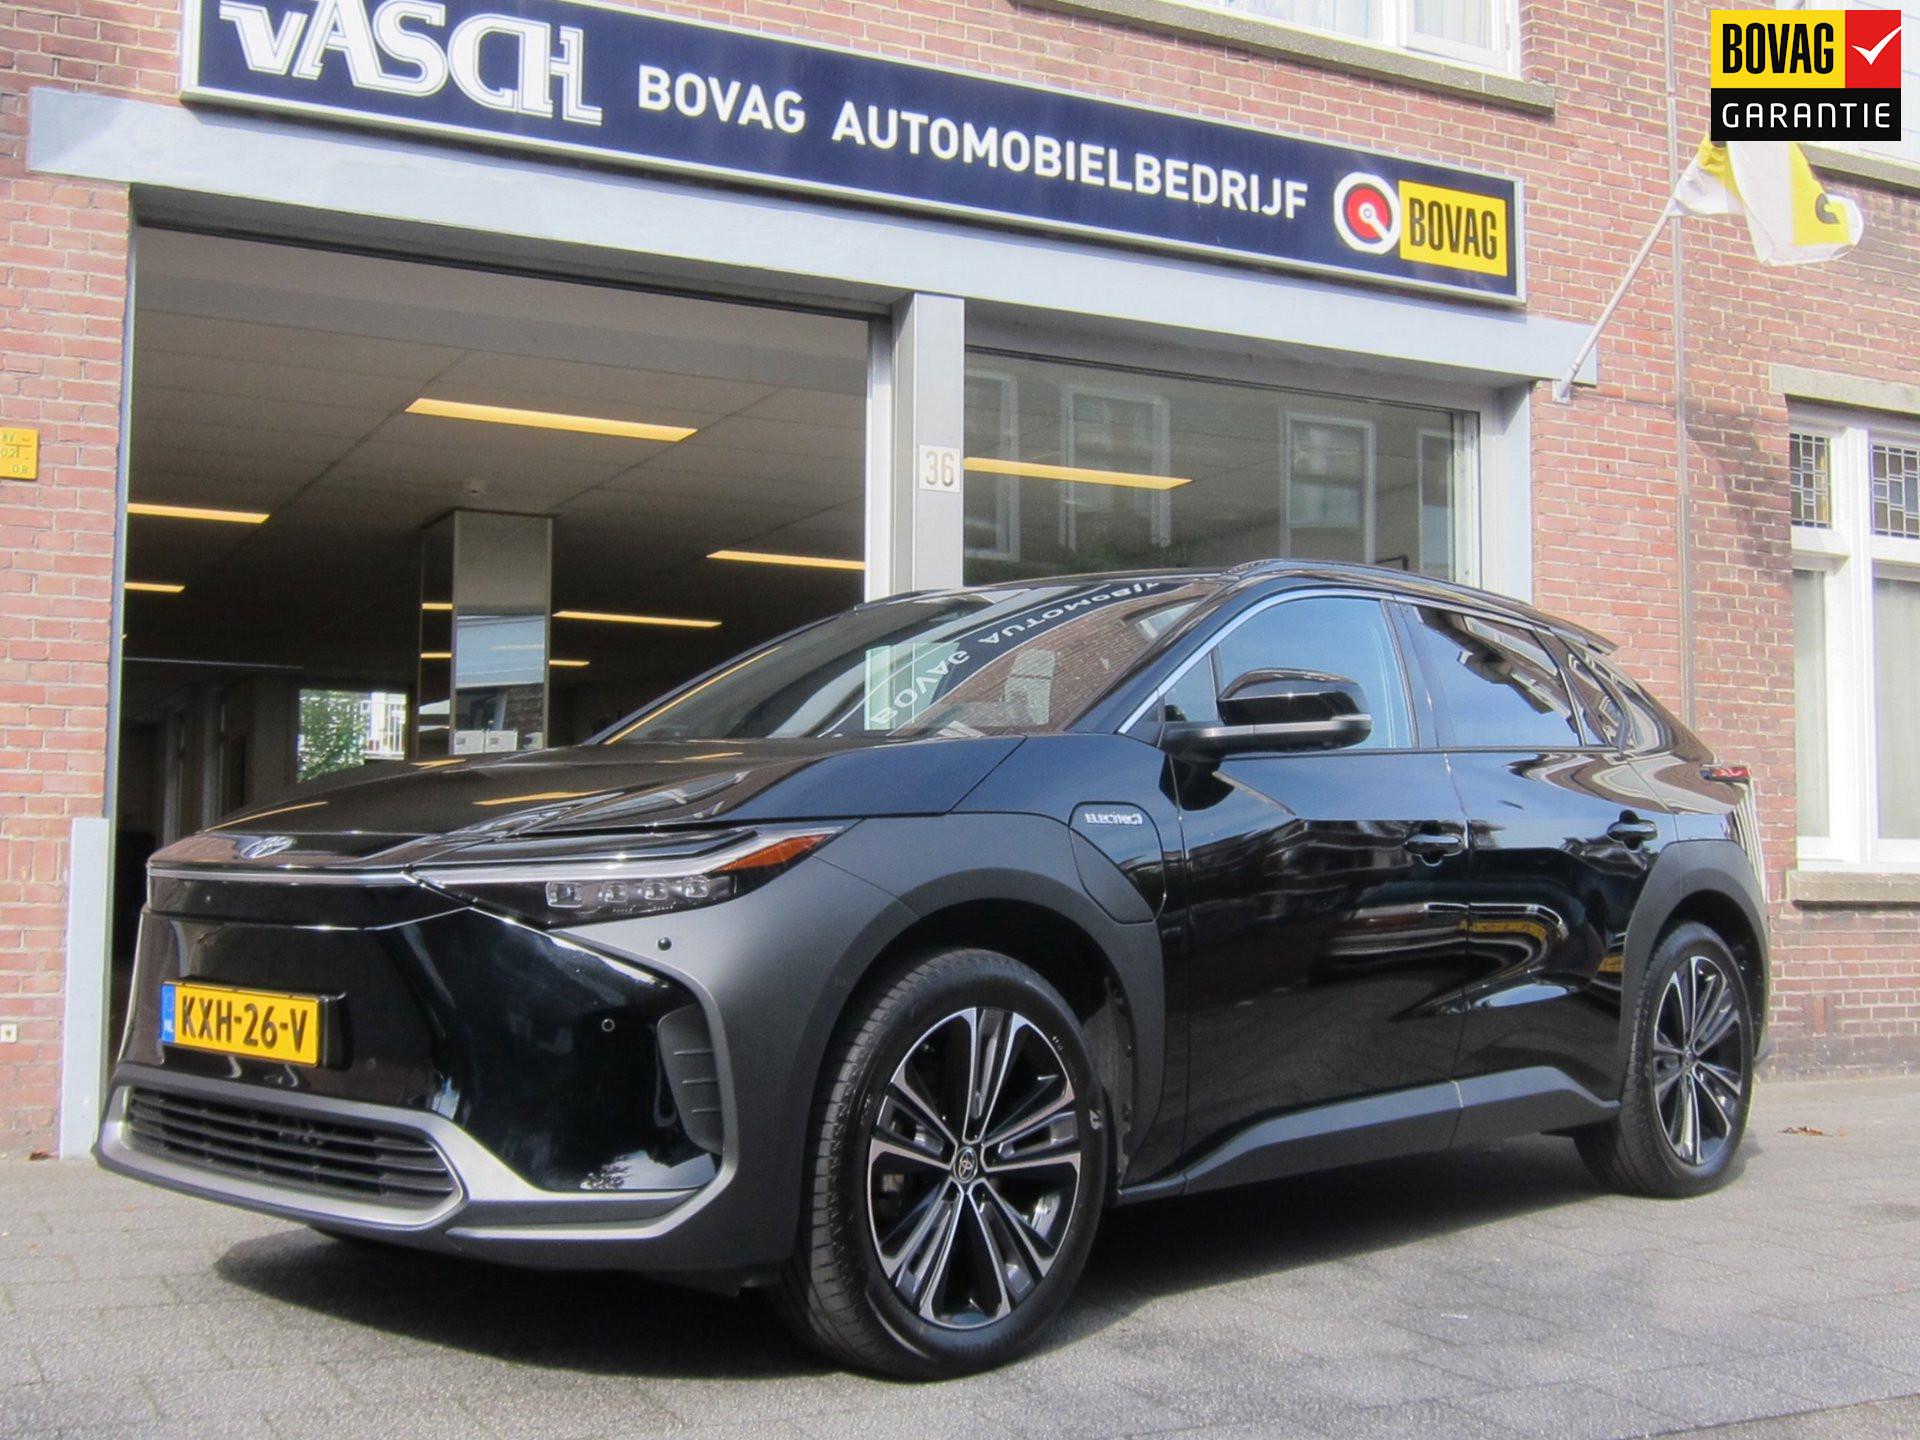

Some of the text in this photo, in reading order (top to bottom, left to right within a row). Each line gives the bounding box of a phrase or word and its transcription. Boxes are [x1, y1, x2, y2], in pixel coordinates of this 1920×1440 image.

[637, 64, 1309, 219] BOVAG AUTOMOBIELBEDRIJF
[1409, 197, 1498, 260] BOVAG
[925, 450, 955, 487] 36
[182, 995, 308, 1053] KXH-26-V
